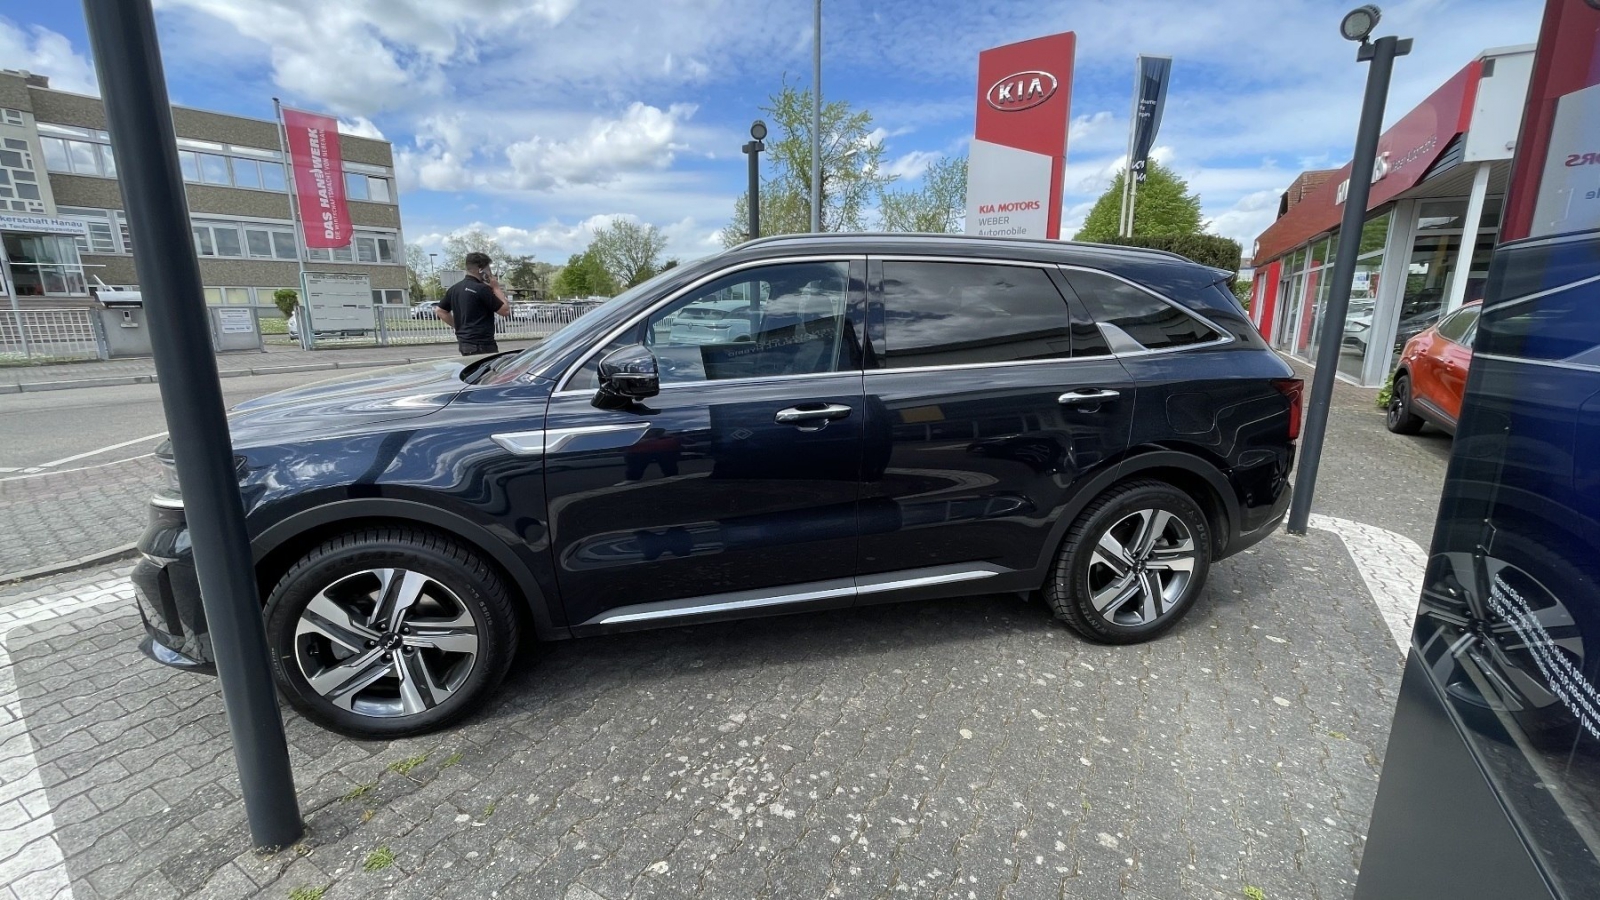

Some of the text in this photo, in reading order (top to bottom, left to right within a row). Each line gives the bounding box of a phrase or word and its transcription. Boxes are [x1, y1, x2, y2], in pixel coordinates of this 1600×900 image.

[999, 78, 1044, 104] KIA
[323, 158, 331, 171] VON
[979, 200, 1040, 214] KIA MOTORS
[51, 219, 83, 228] Hanau
[322, 212, 334, 239] DAS
[979, 216, 1010, 226] WEBER
[978, 226, 1027, 237] Automobile
[1571, 702, 1581, 718] 96
